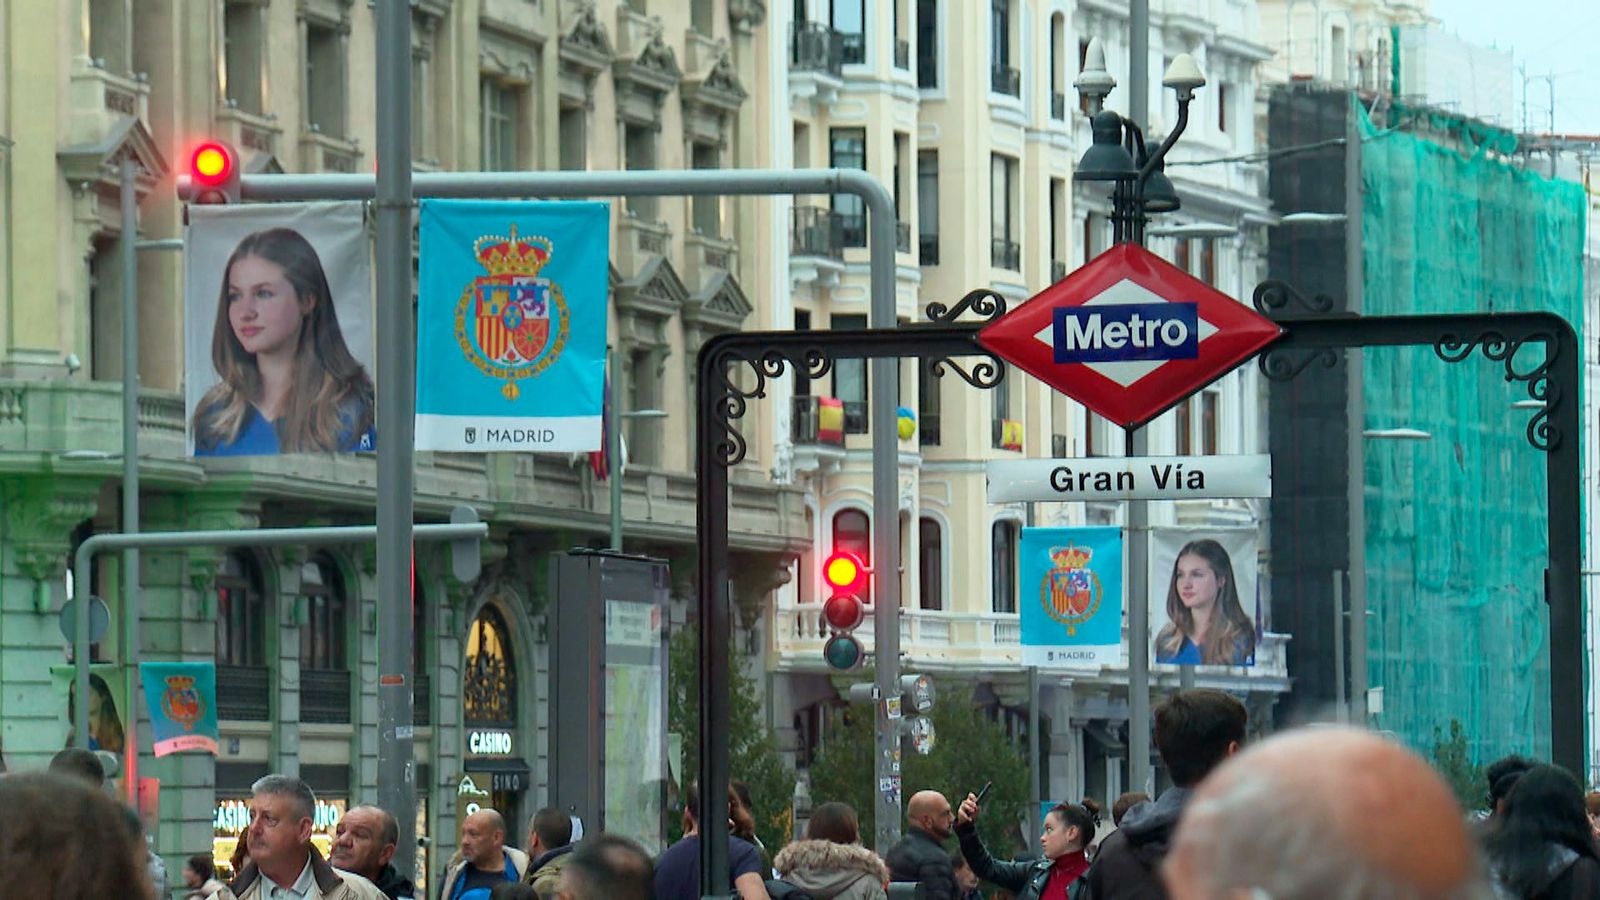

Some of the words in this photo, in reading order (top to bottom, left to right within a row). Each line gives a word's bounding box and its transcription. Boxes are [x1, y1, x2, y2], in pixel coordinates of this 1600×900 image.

[1065, 313, 1188, 351] Metro
[487, 429, 555, 443] MADRID
[1050, 466, 1135, 493] Gran
[1150, 463, 1205, 490] Vía
[470, 732, 512, 754] CASINO
[493, 774, 520, 791] SINO
[212, 805, 251, 829] ASIN
